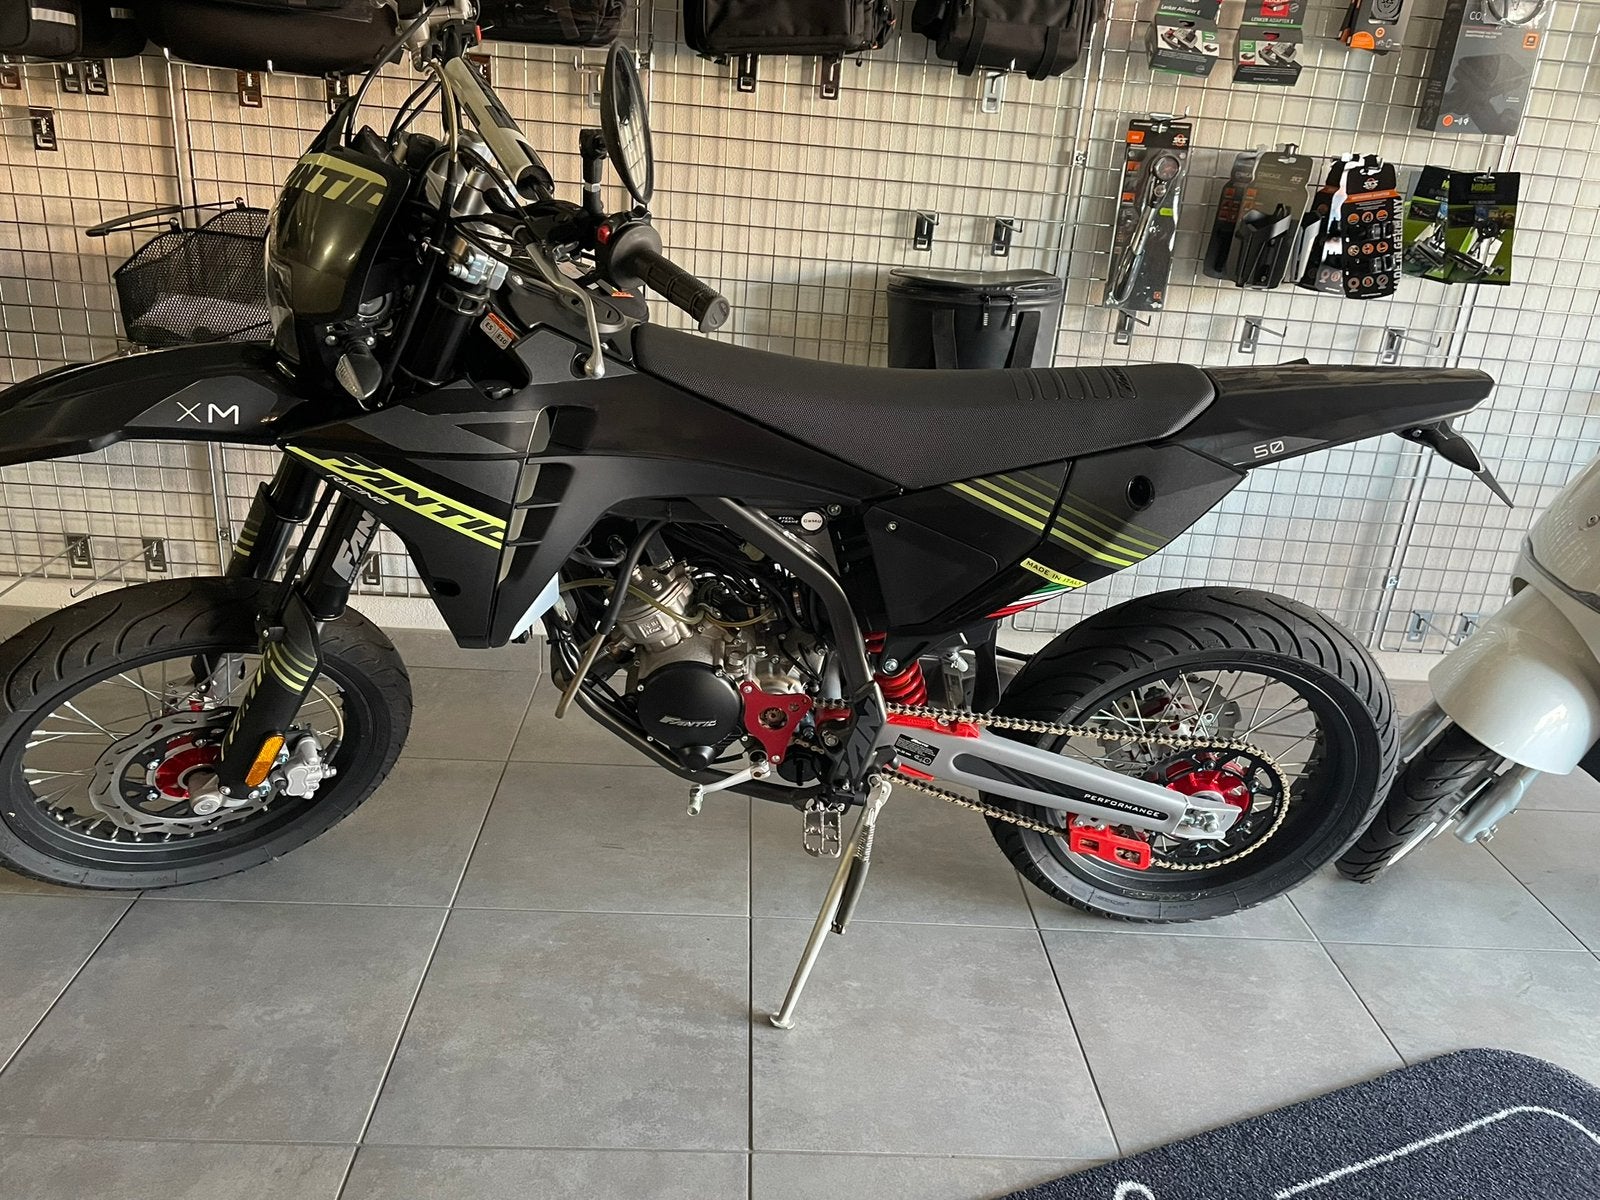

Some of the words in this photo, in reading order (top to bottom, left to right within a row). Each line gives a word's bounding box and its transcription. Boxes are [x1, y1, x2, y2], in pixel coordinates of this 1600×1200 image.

[1471, 182, 1496, 192] MIRAGE
[1393, 199, 1403, 249] GERMANY
[1394, 252, 1402, 262] IN
[484, 321, 495, 332] E5
[495, 331, 511, 347] E10
[176, 401, 240, 426] XM
[1253, 439, 1286, 459] 50
[325, 474, 390, 505] RACING
[1026, 560, 1049, 576] MADE
[1051, 573, 1061, 581] IN
[658, 715, 717, 728] FANTIC
[1083, 793, 1161, 819] PERFORMANCE
